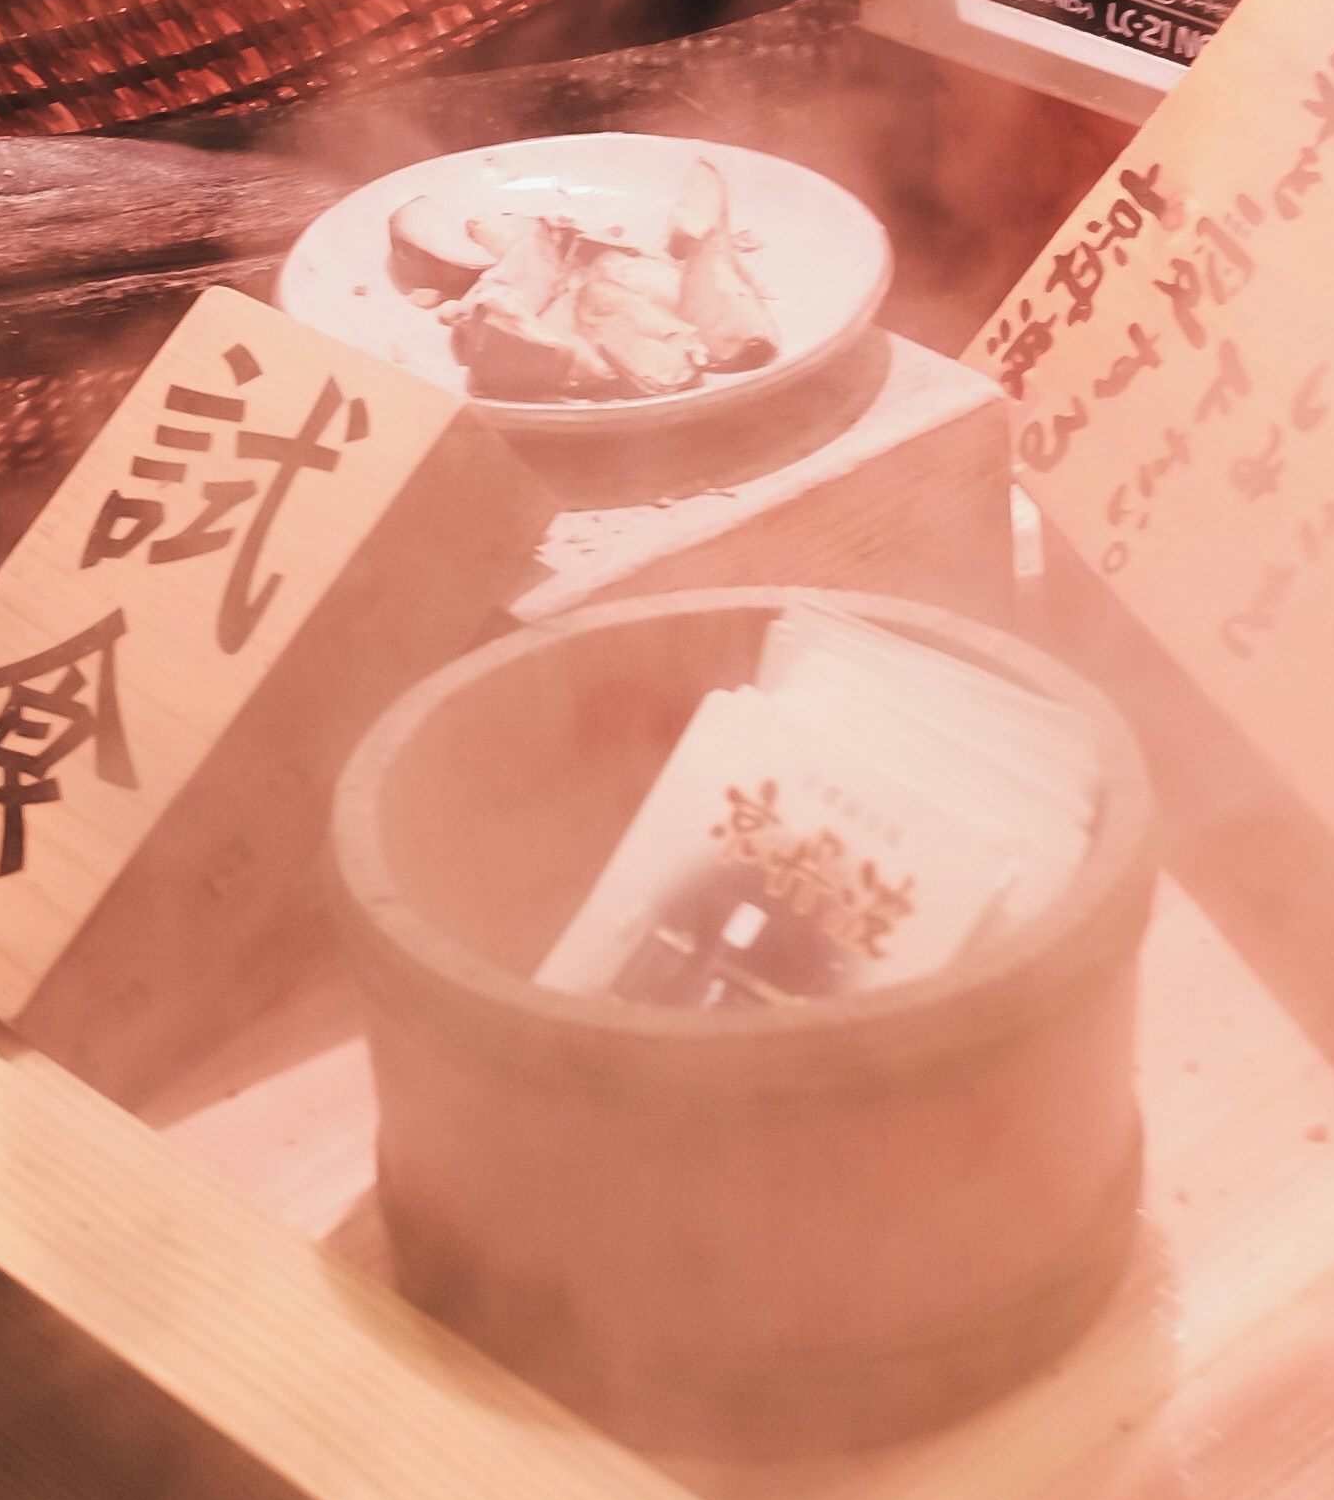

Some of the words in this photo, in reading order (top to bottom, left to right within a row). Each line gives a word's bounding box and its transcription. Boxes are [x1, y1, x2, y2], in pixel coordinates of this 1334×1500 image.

[985, 162, 1171, 400] 京丹波
[1102, 338, 1251, 574] 下さい。
